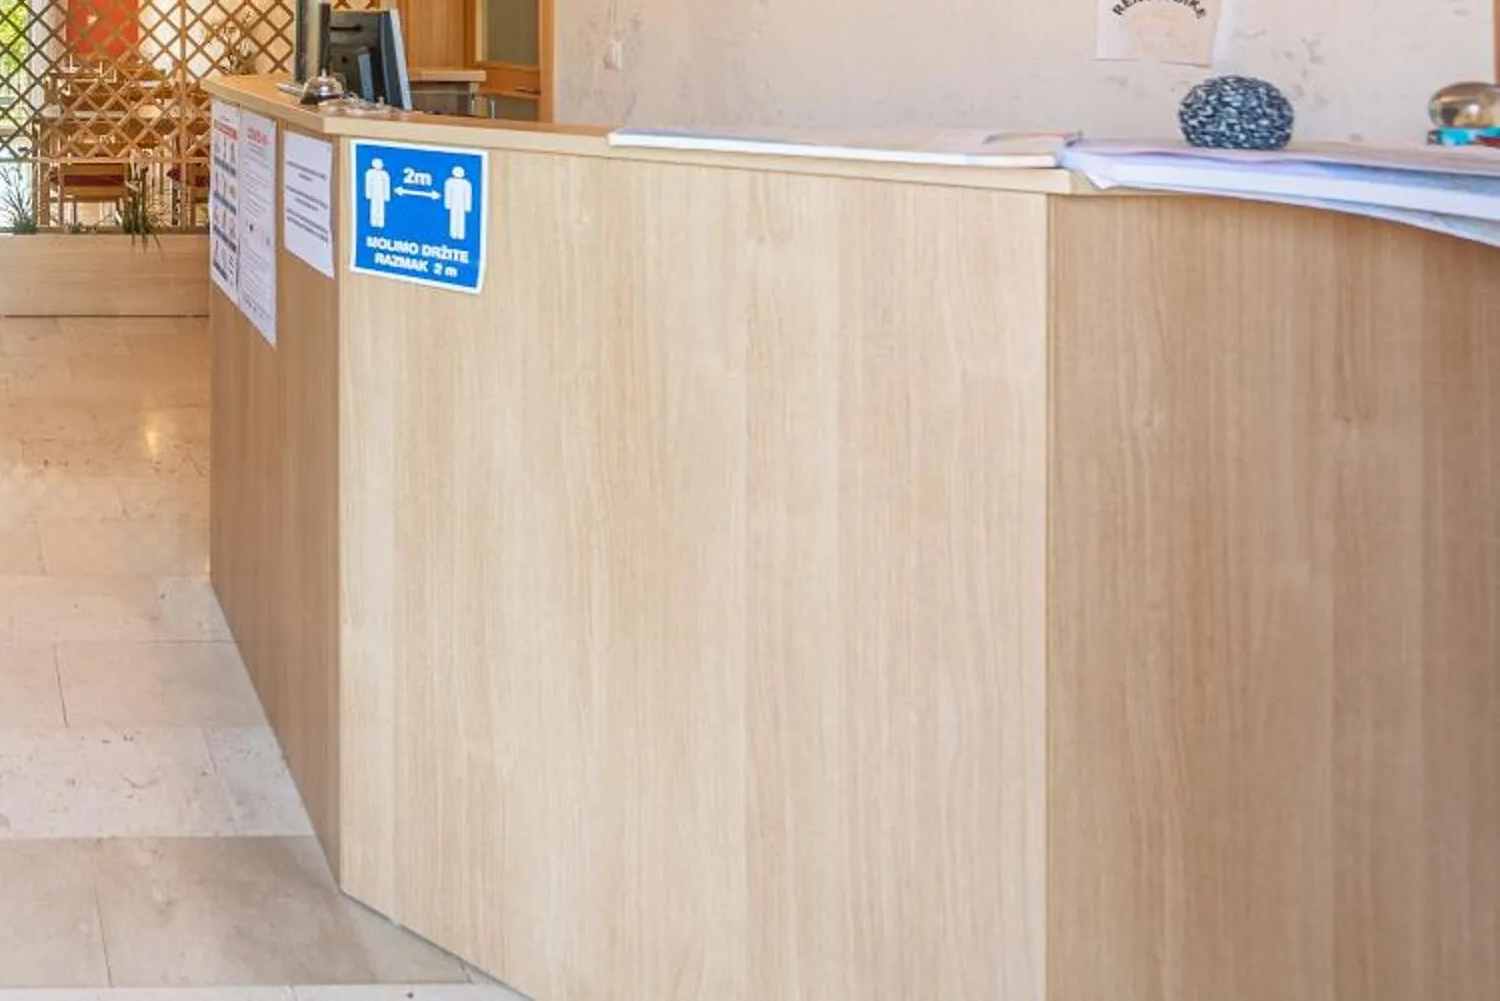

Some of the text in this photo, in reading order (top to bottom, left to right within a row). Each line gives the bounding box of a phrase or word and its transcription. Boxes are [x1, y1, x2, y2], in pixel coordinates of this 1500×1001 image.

[402, 166, 432, 186] 2m
[366, 235, 469, 264] MOLIMO DRŽITE
[374, 252, 458, 278] RAZMAK 2 m
